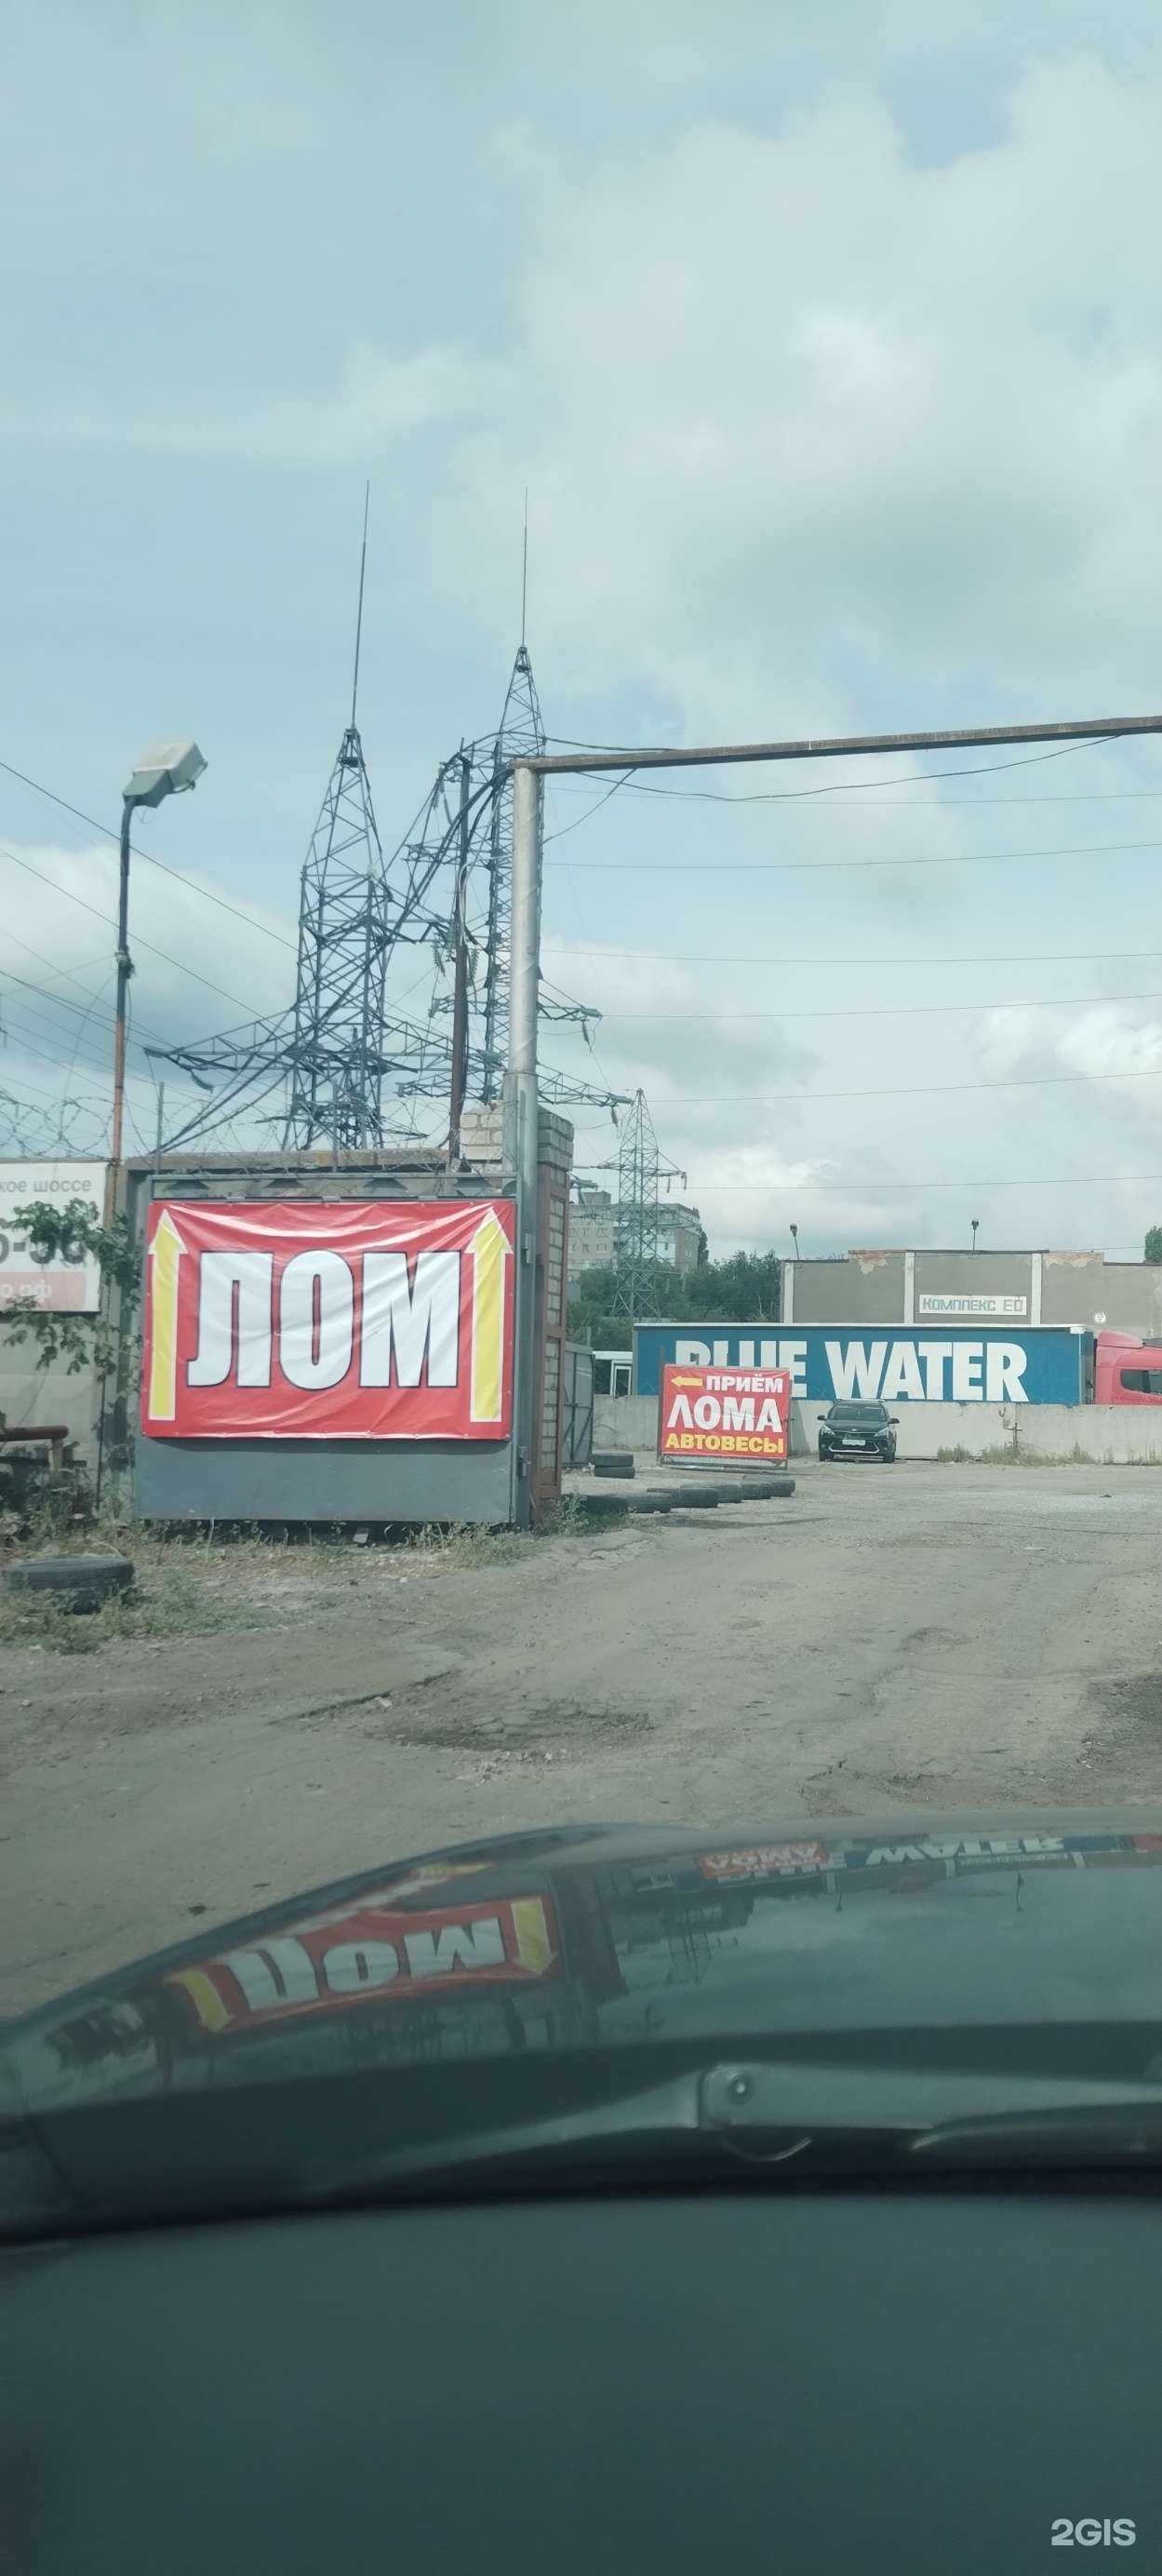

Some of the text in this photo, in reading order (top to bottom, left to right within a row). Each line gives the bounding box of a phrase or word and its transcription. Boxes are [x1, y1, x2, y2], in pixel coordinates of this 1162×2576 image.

[33, 1179, 92, 1193] шоссе
[185, 1250, 462, 1390] ЛОМ
[706, 1374, 783, 1393] ПРИЁМ
[824, 1341, 1030, 1402] WATER
[666, 1394, 782, 1433] ЛОМА
[665, 1433, 784, 1454] АВТОВЕСЫ
